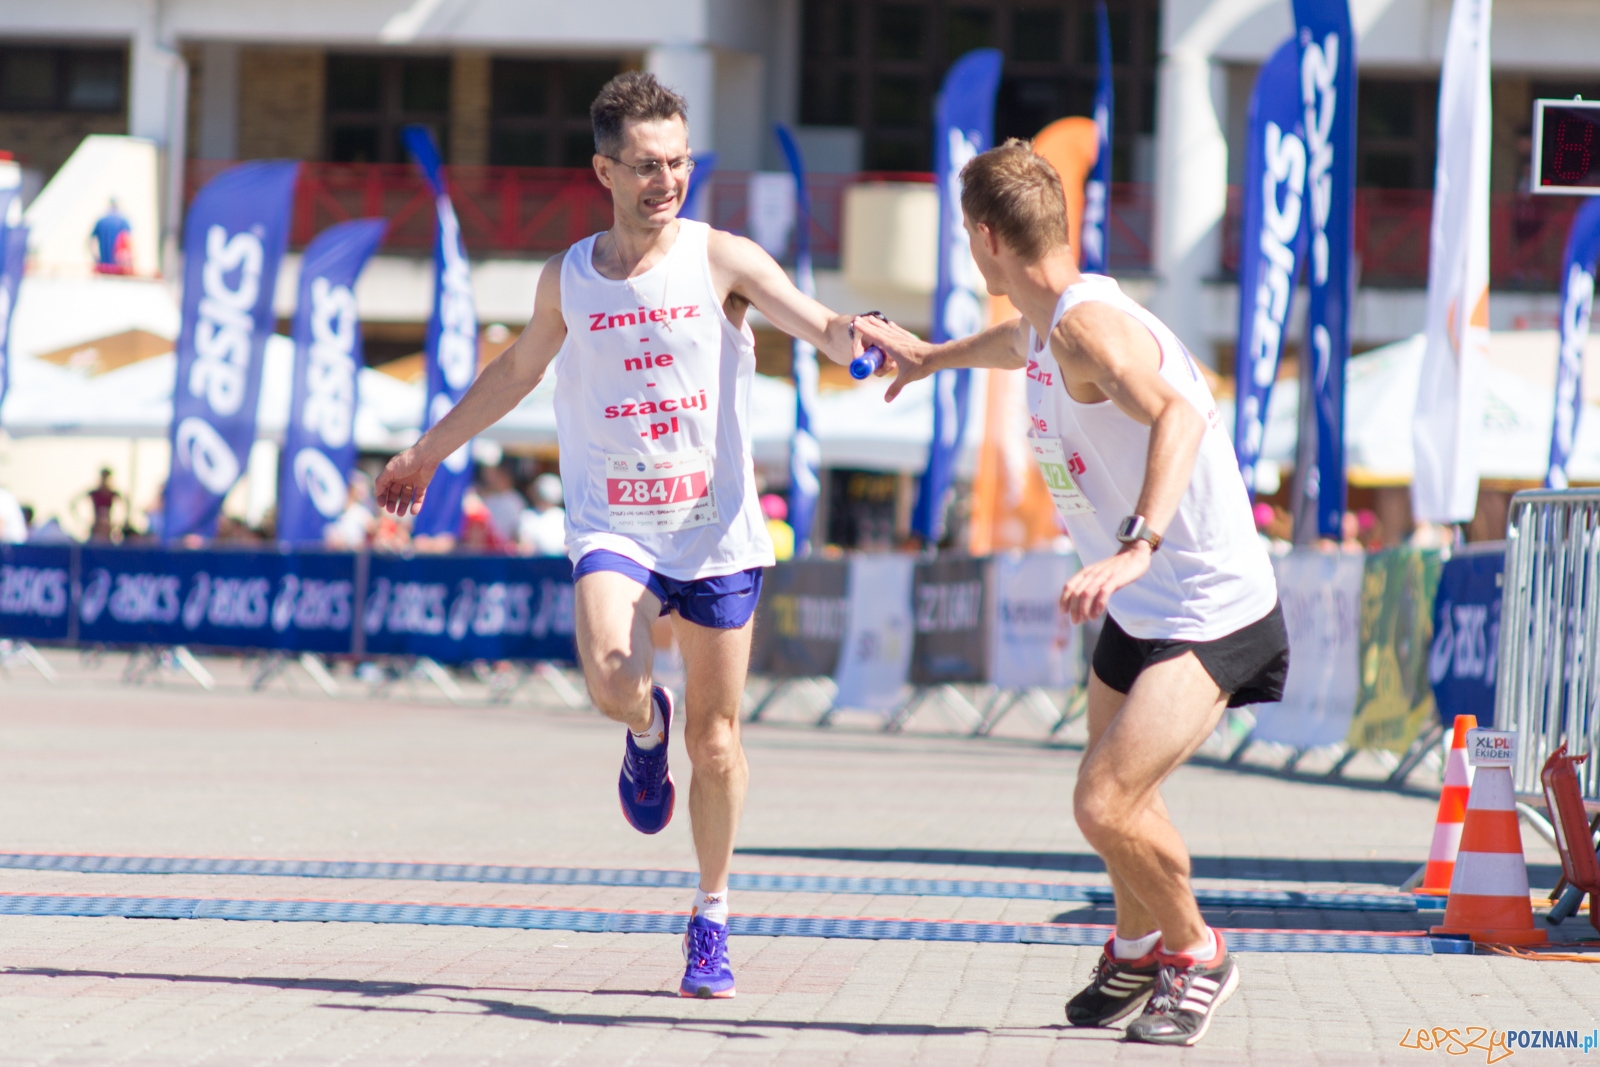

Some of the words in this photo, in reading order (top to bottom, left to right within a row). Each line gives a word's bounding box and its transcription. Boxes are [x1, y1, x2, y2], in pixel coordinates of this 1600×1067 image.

[589, 305, 700, 331] Zmierz
[624, 352, 674, 372] nie
[604, 389, 708, 419] szacuj
[617, 475, 694, 503] 284/1
[1475, 749, 1510, 758] EKIDEN
